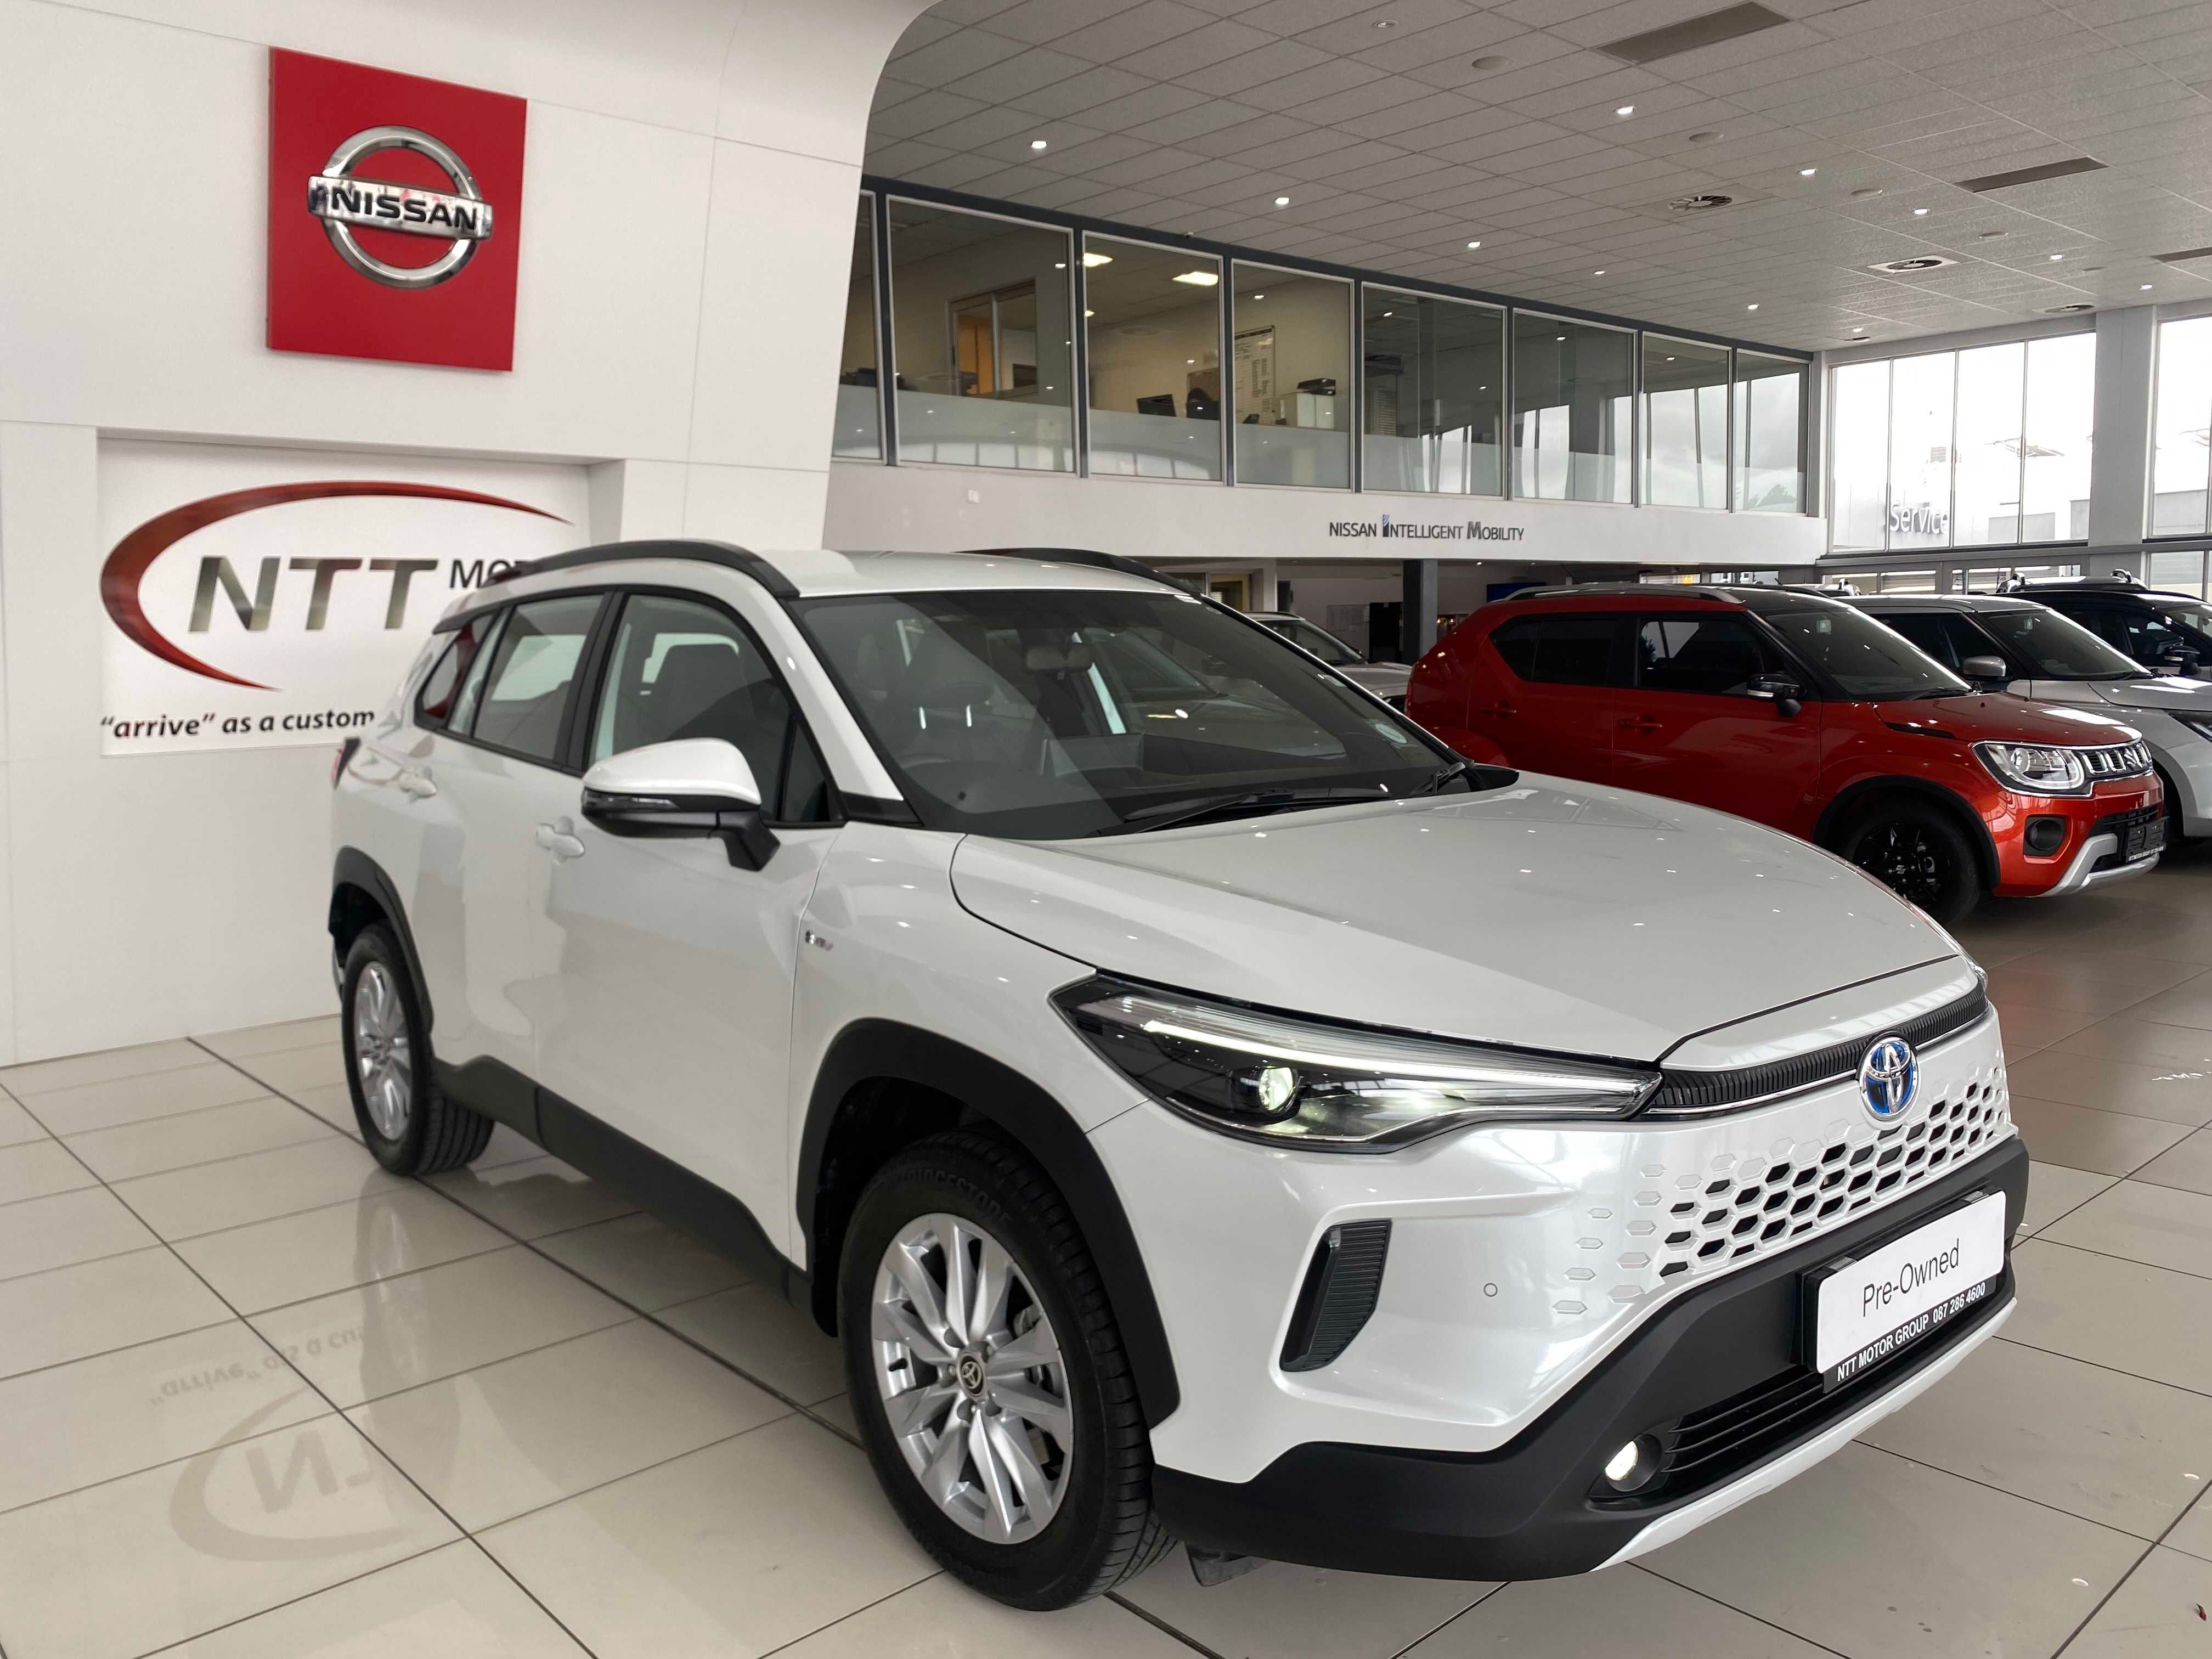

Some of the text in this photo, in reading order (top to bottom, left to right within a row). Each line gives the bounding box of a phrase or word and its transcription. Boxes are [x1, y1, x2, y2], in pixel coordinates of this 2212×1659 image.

[330, 187, 478, 230] NISSAN
[1329, 515, 1525, 540] NISSAN INTELLIGENT MOBILITY
[1890, 500, 1949, 534] Service
[188, 555, 527, 632] NTT MO
[222, 715, 251, 733] as
[259, 715, 274, 731] a
[1863, 1238, 1959, 1318] Pre-Owned
[1837, 1282, 1986, 1381] NTT MOTOR GROUP 087 286 4600
